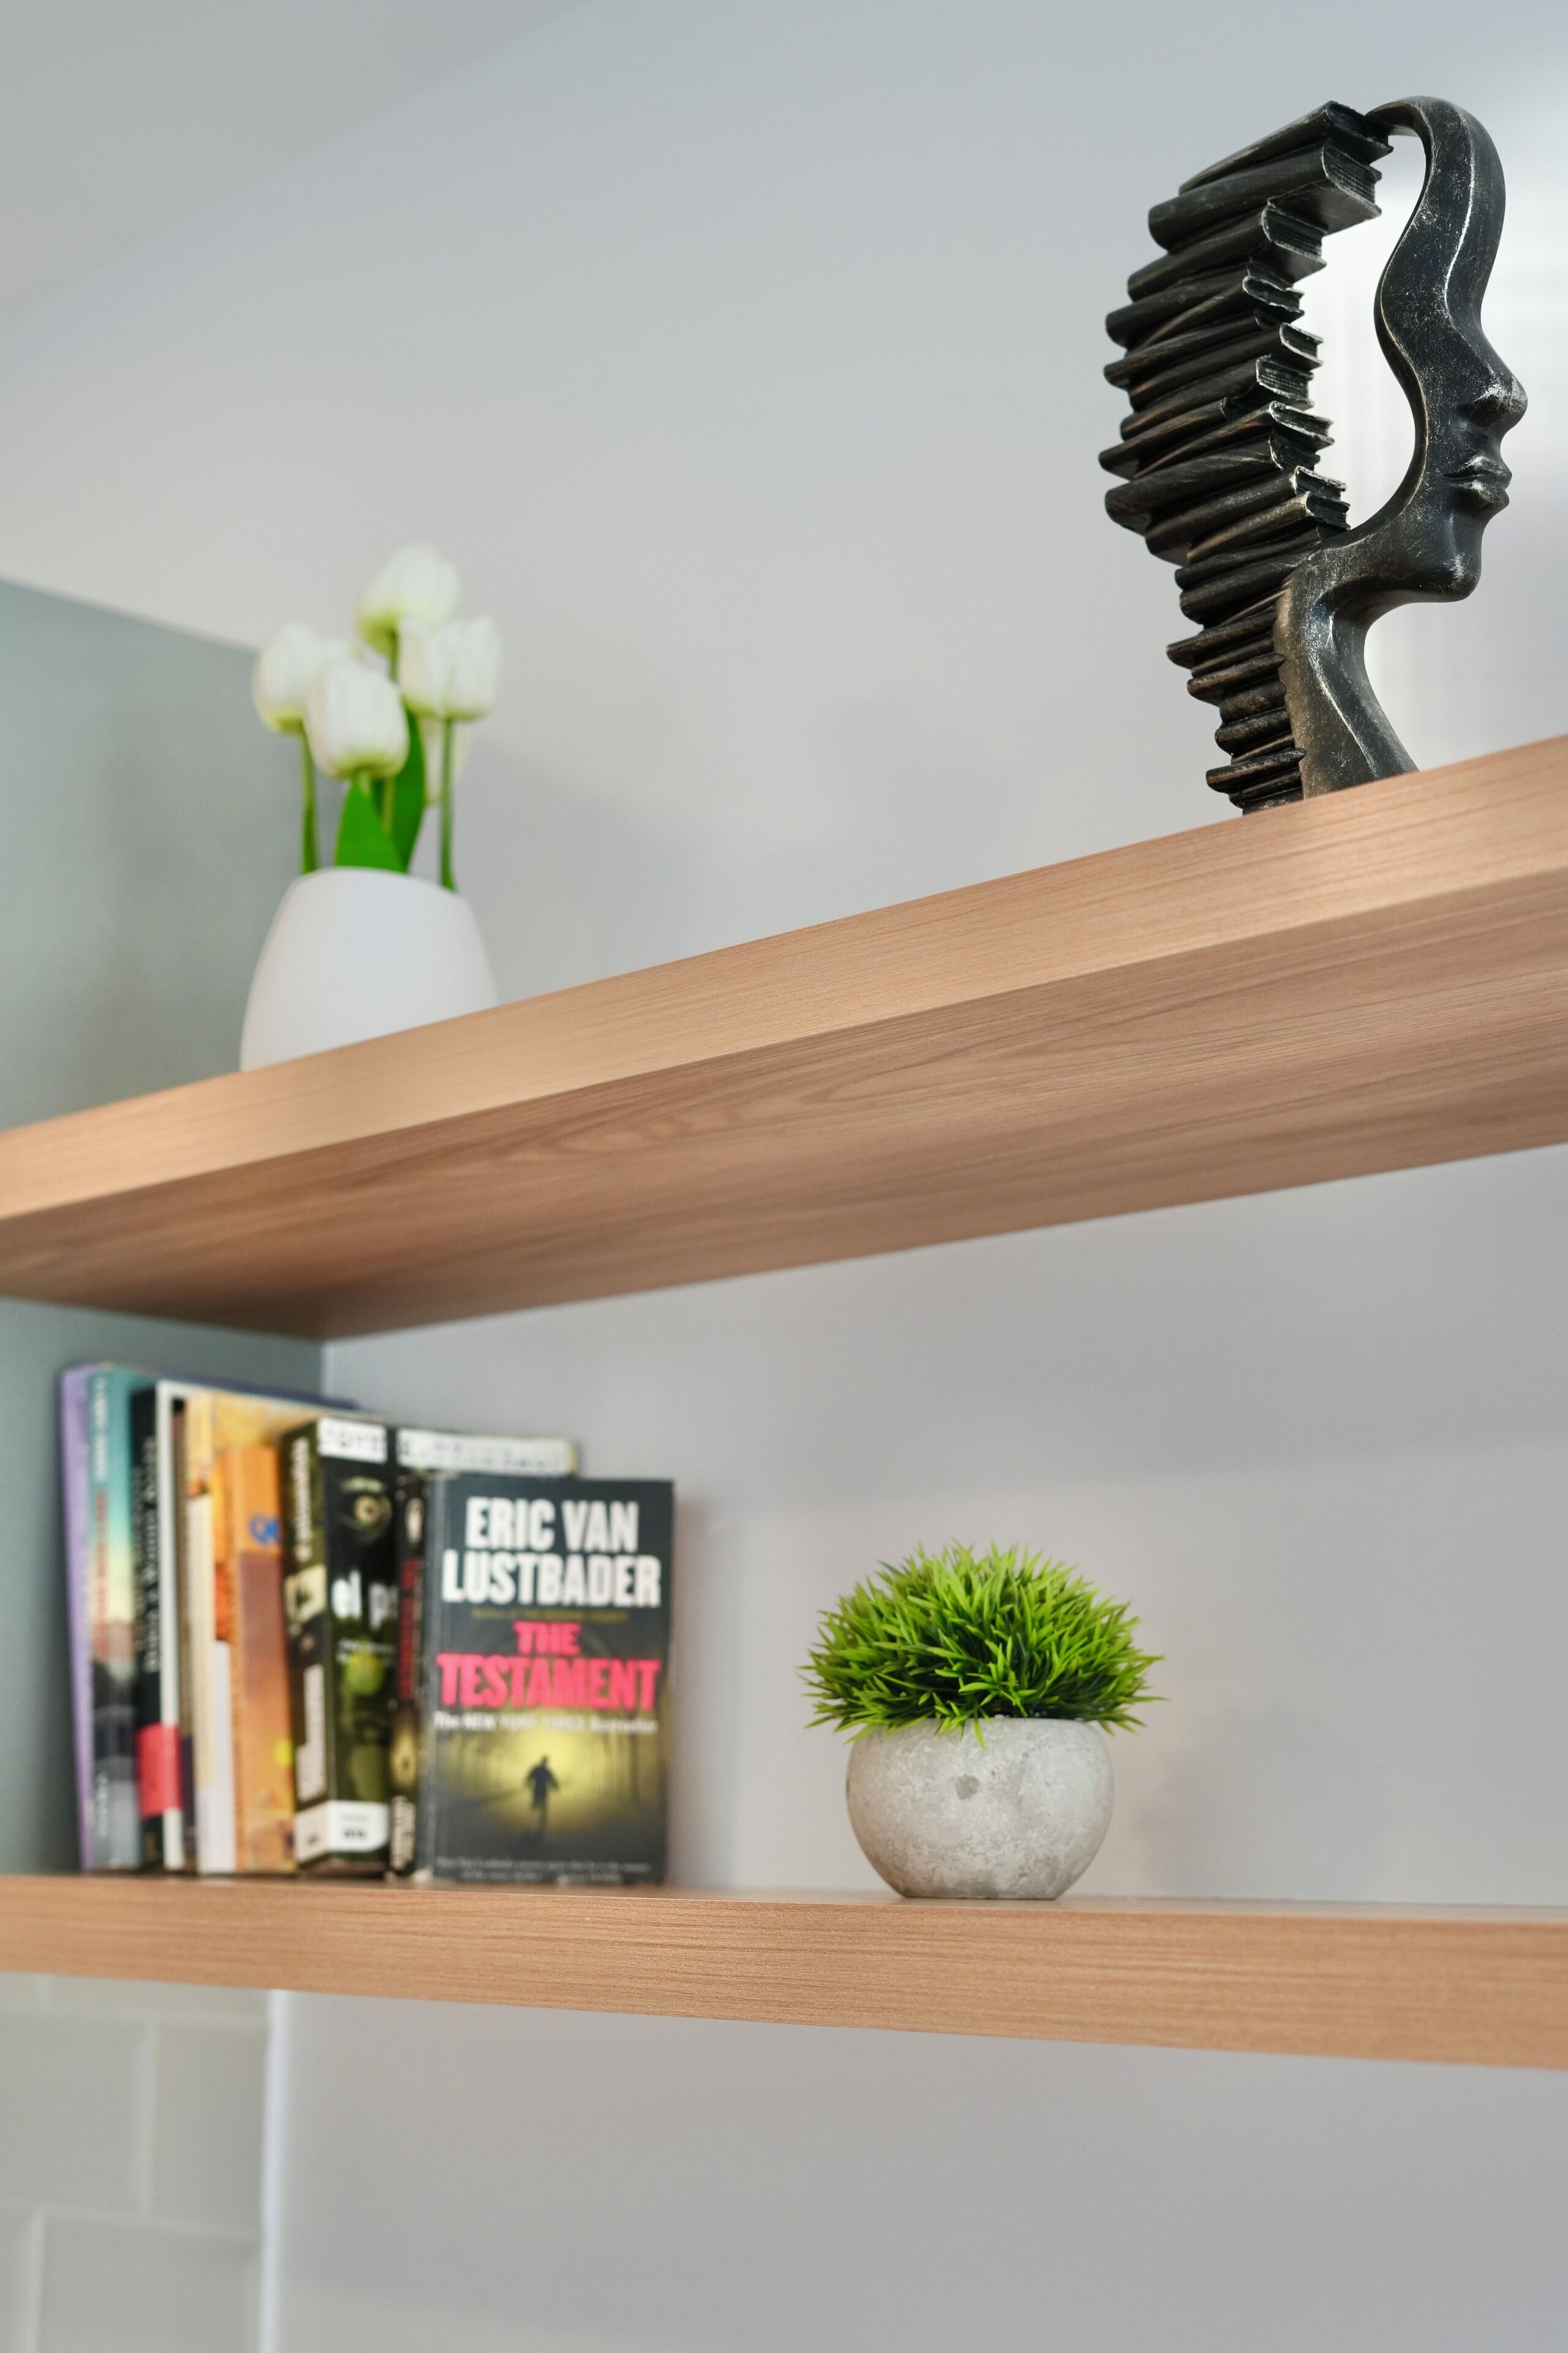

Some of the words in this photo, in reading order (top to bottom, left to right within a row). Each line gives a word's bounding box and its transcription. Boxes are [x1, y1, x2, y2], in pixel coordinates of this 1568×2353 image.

[465, 1496, 556, 1551] ERIC
[561, 1499, 640, 1553] VAN
[442, 1548, 662, 1607] LUSTBADER
[513, 1621, 581, 1654] THE
[436, 1653, 661, 1711] TESTAMENT
